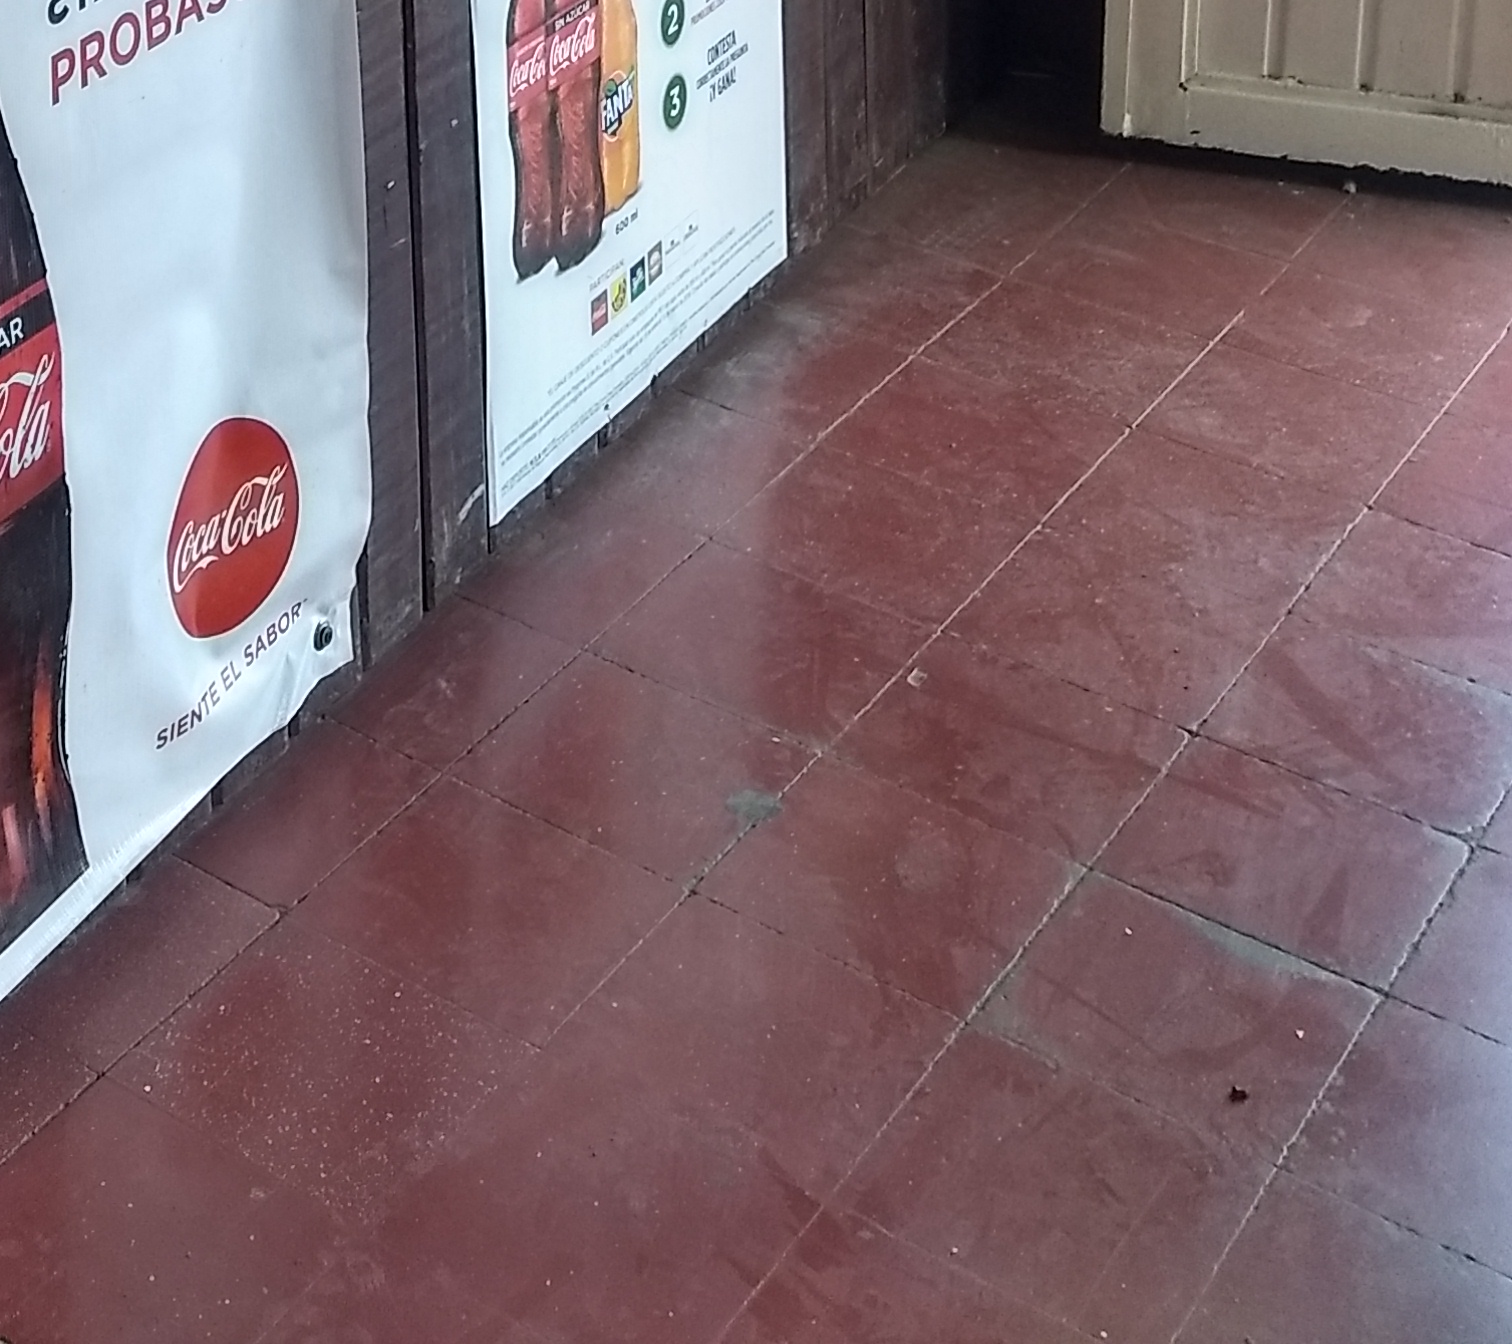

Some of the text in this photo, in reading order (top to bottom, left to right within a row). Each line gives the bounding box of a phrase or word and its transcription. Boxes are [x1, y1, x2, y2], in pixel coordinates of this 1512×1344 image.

[666, 2, 680, 36] 2
[706, 29, 738, 67] CONTESTA
[601, 80, 634, 132] FANTA
[668, 84, 681, 118] 3
[614, 215, 629, 237] 600
[154, 600, 304, 752] SIENTE EL SABOR
